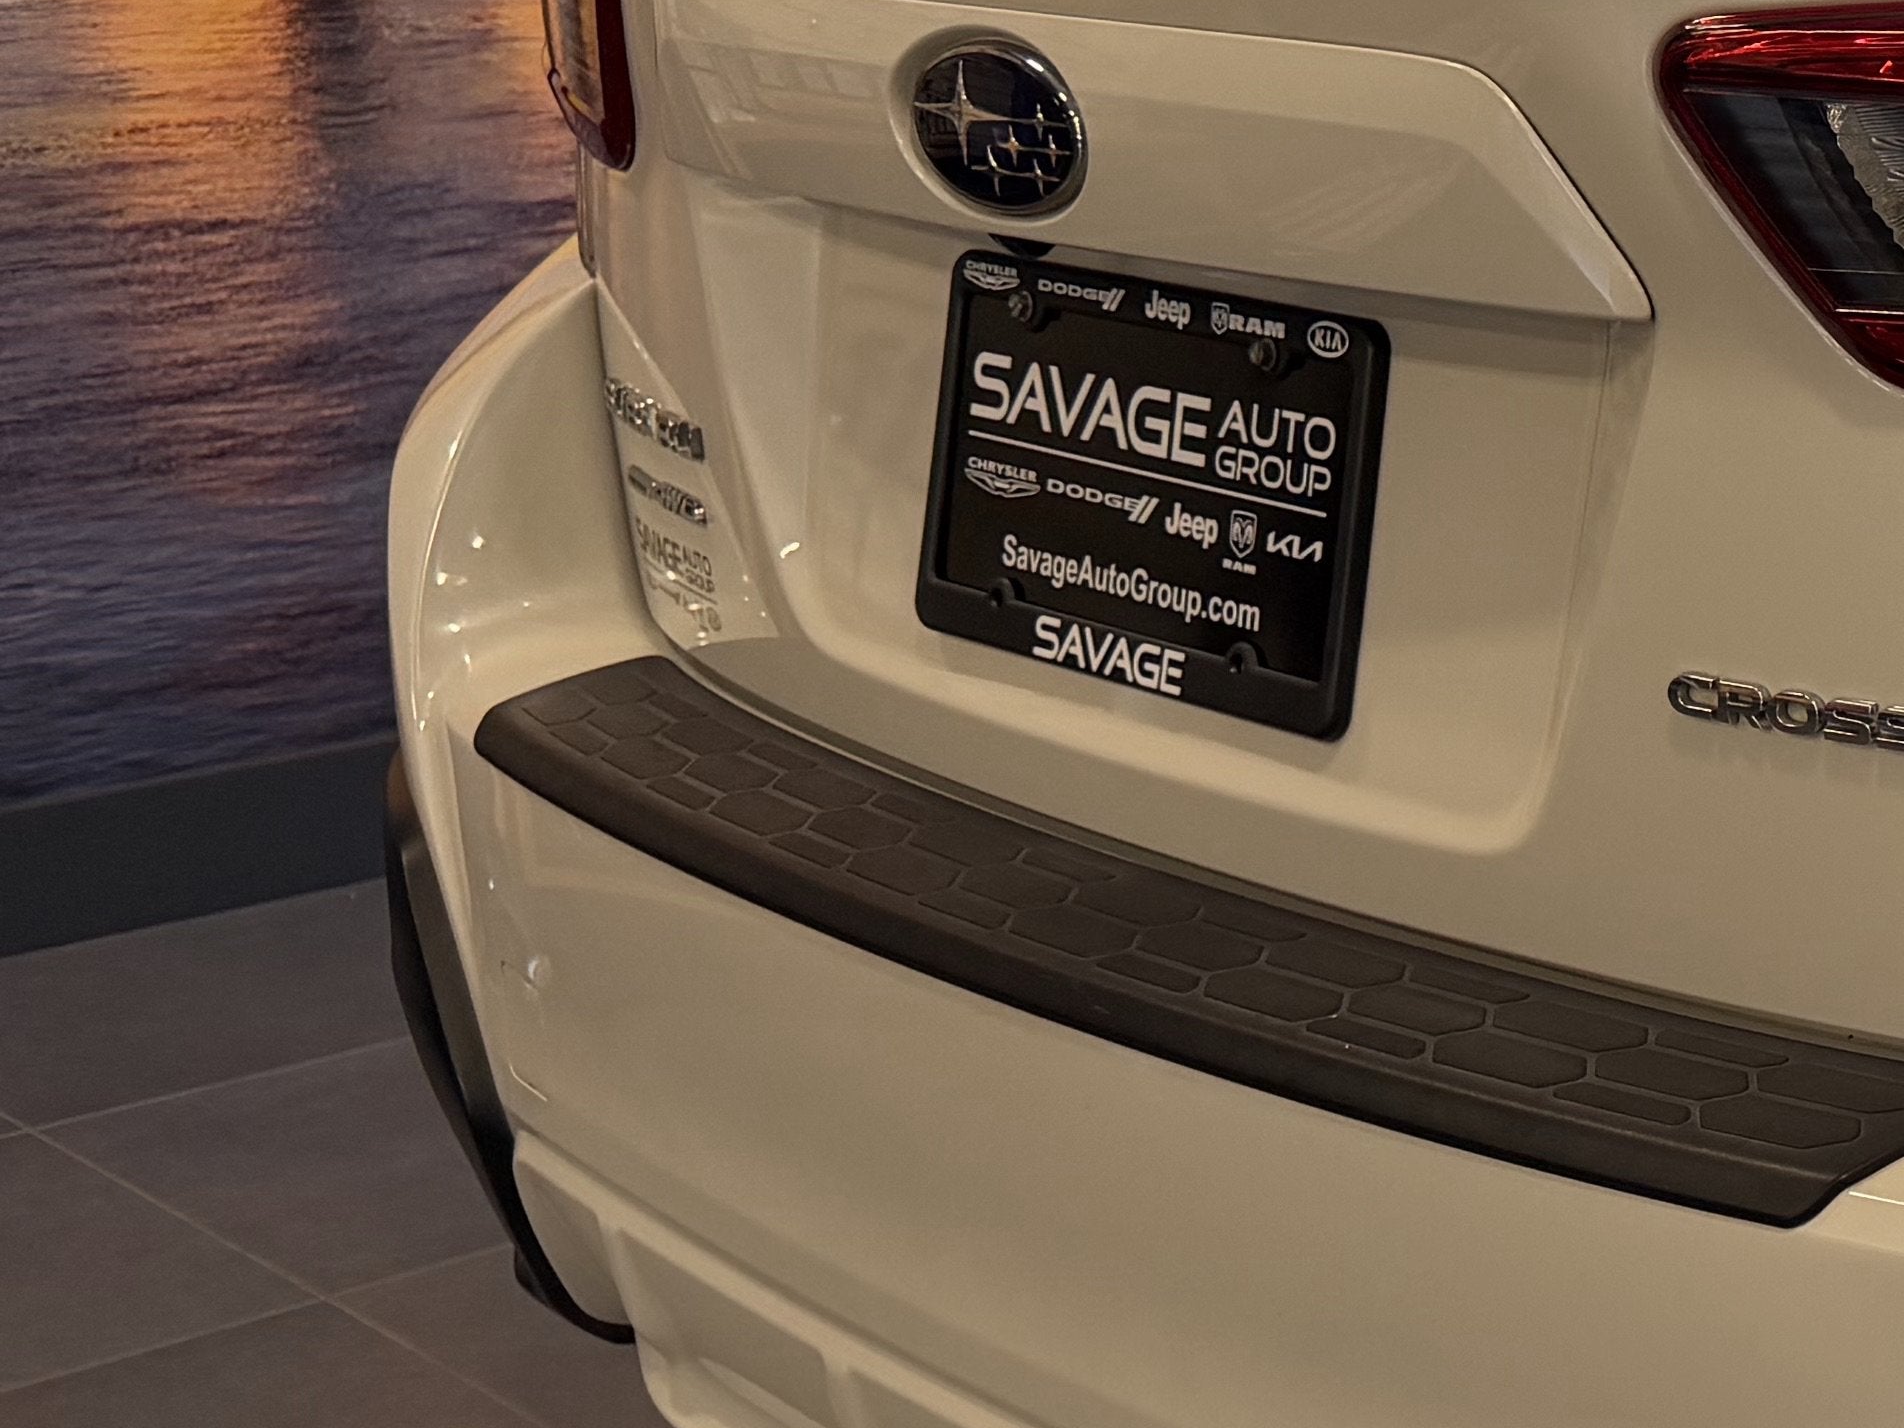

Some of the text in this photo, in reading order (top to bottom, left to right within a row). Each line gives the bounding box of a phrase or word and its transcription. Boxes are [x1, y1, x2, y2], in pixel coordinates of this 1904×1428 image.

[1038, 278, 1112, 302] DODGE
[1145, 289, 1192, 330] Jeep
[1228, 313, 1286, 339] RAM
[1314, 327, 1343, 352] KIA
[969, 350, 1337, 468] SAVAGE AUTO
[967, 456, 1039, 483] CHRYSLER
[1046, 477, 1141, 512] DODGE
[1164, 502, 1219, 550] Jeep
[1222, 557, 1257, 576] RAM
[1214, 446, 1332, 498] GROUP
[1002, 533, 1261, 633] SavageAutoGroup.com
[1032, 614, 1187, 697] SAVAGE
